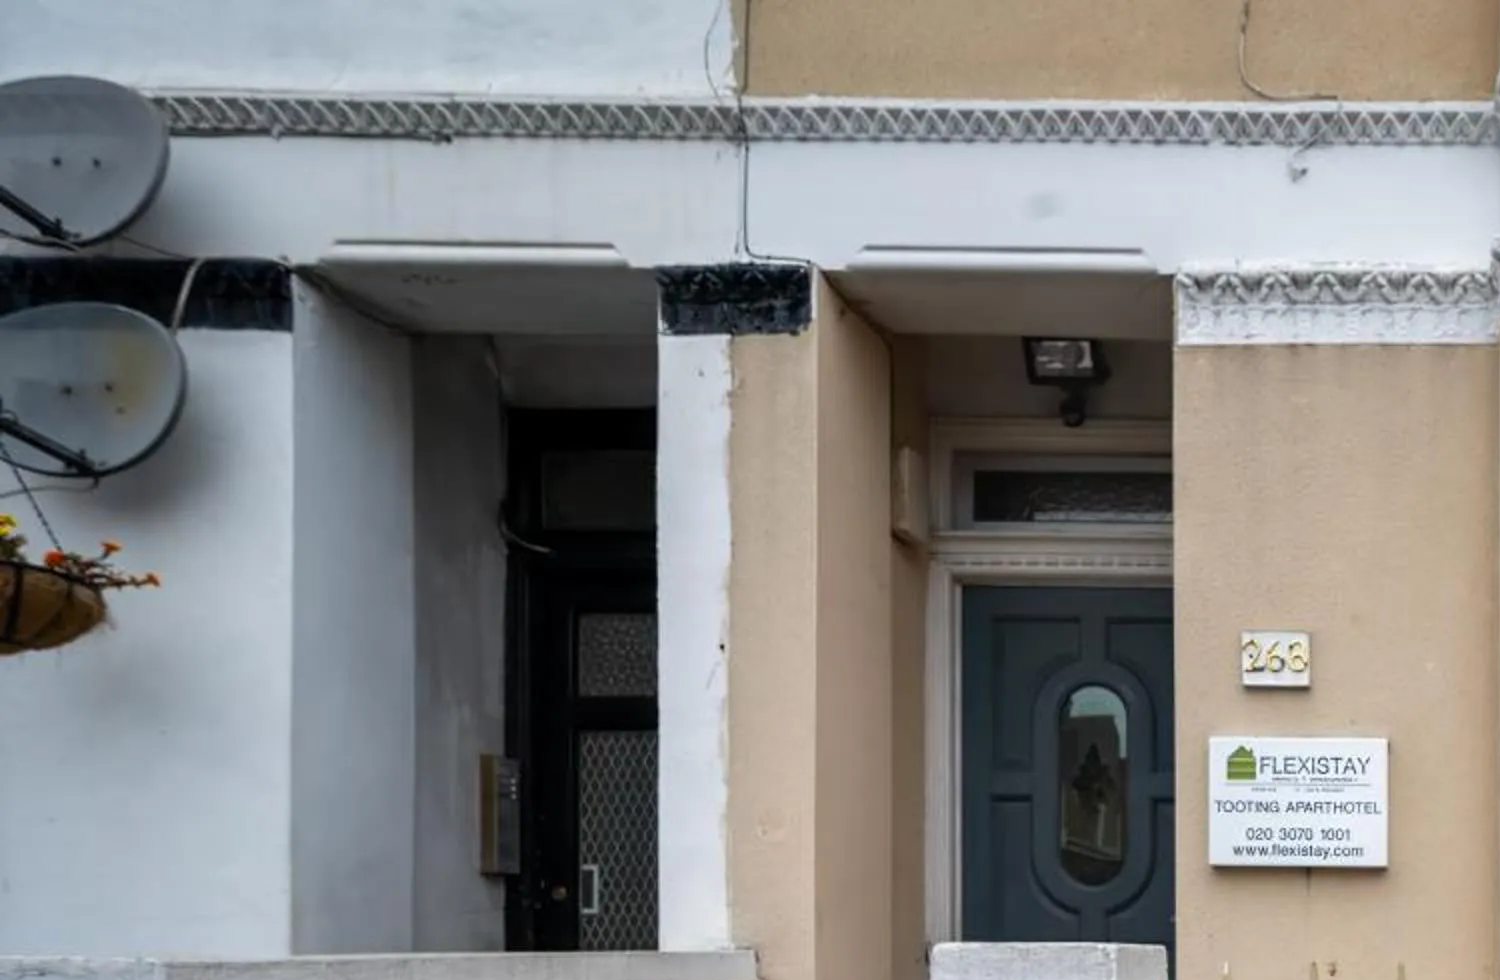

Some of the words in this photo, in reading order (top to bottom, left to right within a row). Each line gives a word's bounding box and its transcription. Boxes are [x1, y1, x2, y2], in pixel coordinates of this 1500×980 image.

[1259, 756, 1371, 775] FLEXISTAY
[1214, 799, 1281, 814] TOOTING
[1285, 800, 1383, 815] APARTHOTEL
[1245, 827, 1274, 841] 020
[1278, 827, 1314, 841] 3070
[1320, 827, 1352, 841] 1001
[1232, 843, 1364, 860] www.flexistay.com
